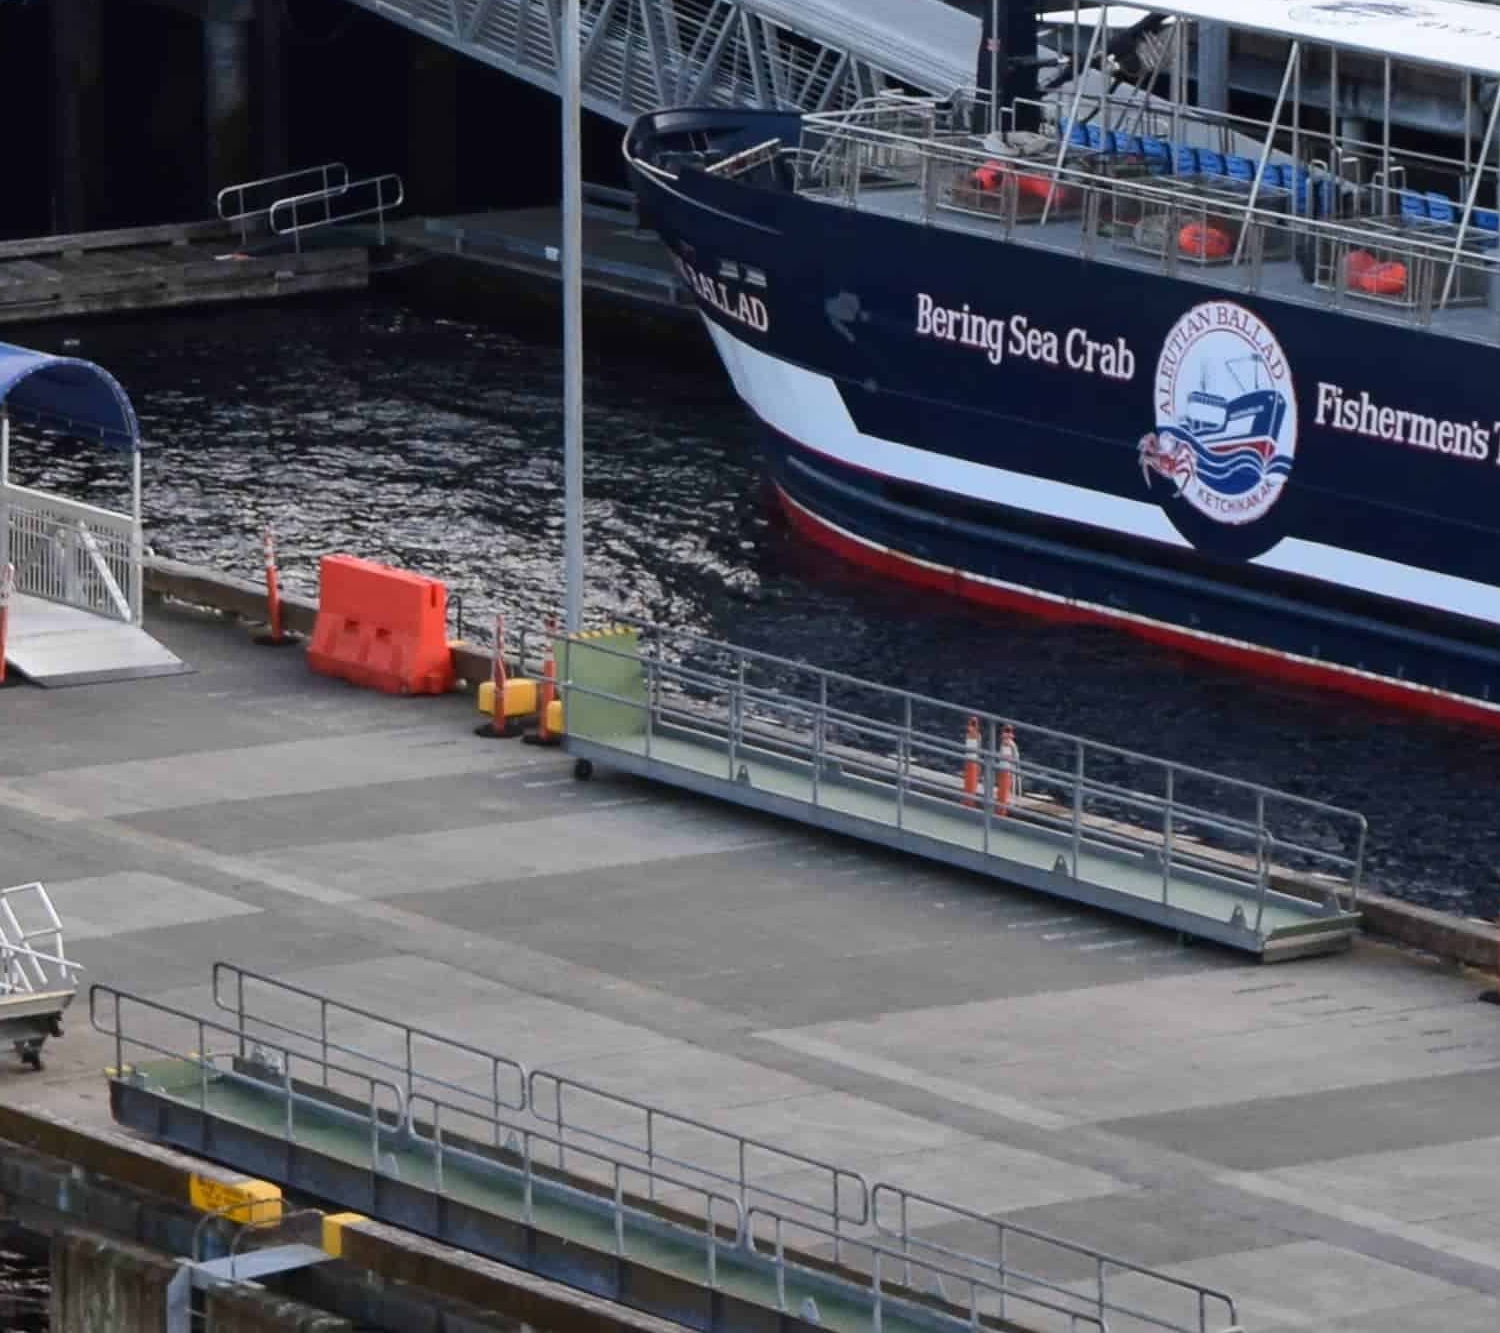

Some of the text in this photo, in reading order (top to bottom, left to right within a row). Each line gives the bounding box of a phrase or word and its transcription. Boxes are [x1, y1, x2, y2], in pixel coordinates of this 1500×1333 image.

[916, 292, 1135, 381] Bering Sea Crab
[1159, 305, 1286, 416] ALEUTIAN BALLAD
[1314, 381, 1489, 461] Fishermen's
[1197, 488, 1262, 514] KETCHIKAN
